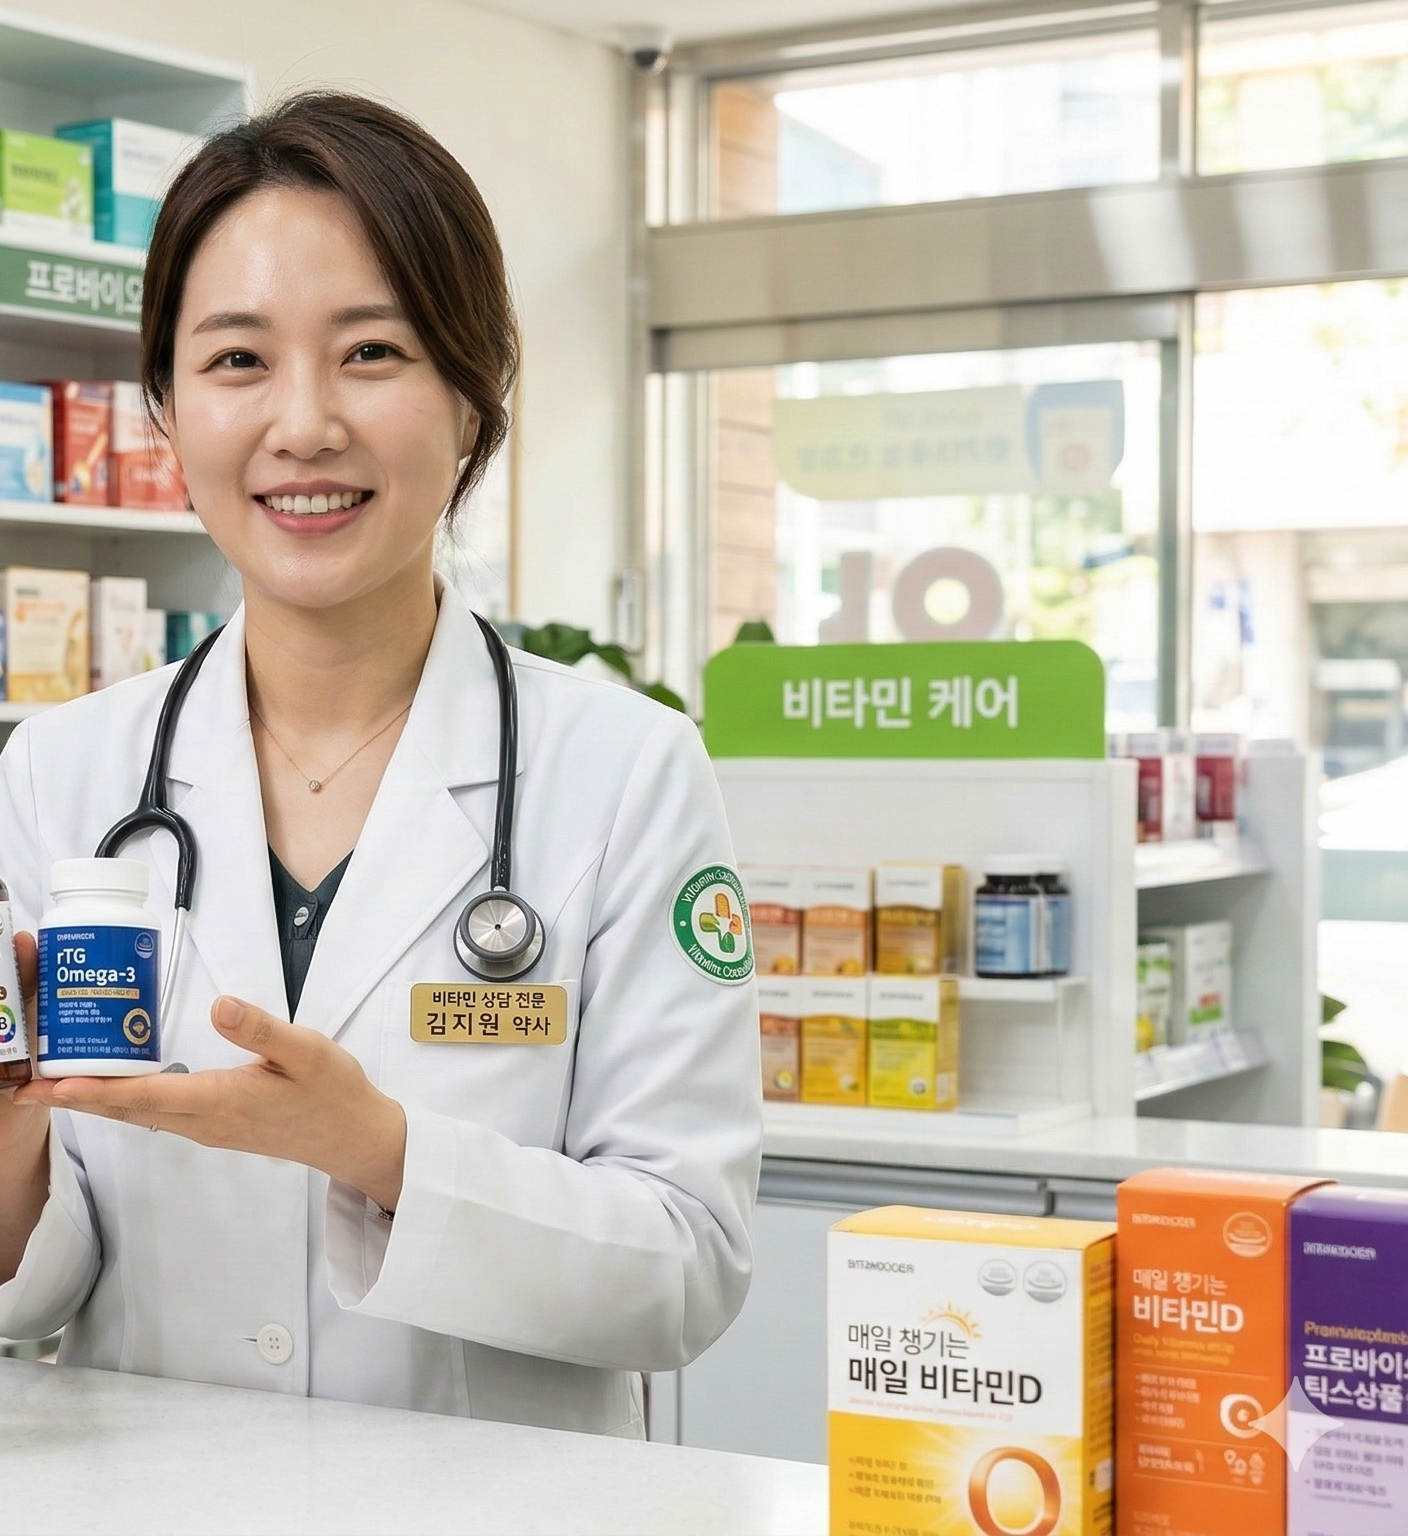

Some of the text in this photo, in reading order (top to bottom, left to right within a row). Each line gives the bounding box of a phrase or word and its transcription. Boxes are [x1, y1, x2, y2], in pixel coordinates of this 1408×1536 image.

[24, 260, 143, 315] 프로바이오
[783, 676, 1019, 729] 비타민 케어
[57, 948, 86, 965] rTG
[57, 966, 136, 986] Omega-3
[432, 991, 476, 1008] 비타민
[481, 991, 512, 1008] 상담
[426, 1012, 551, 1036] 김지원 약사
[1133, 1268, 1228, 1297] 매일 챙기는
[1133, 1294, 1245, 1334] 비타민D
[848, 1323, 970, 1360] 매일 챙기는
[849, 1357, 1043, 1406] 매일 비타민D
[1303, 1343, 1408, 1382] 프로바이
[1304, 1374, 1408, 1415] 틱스상품
